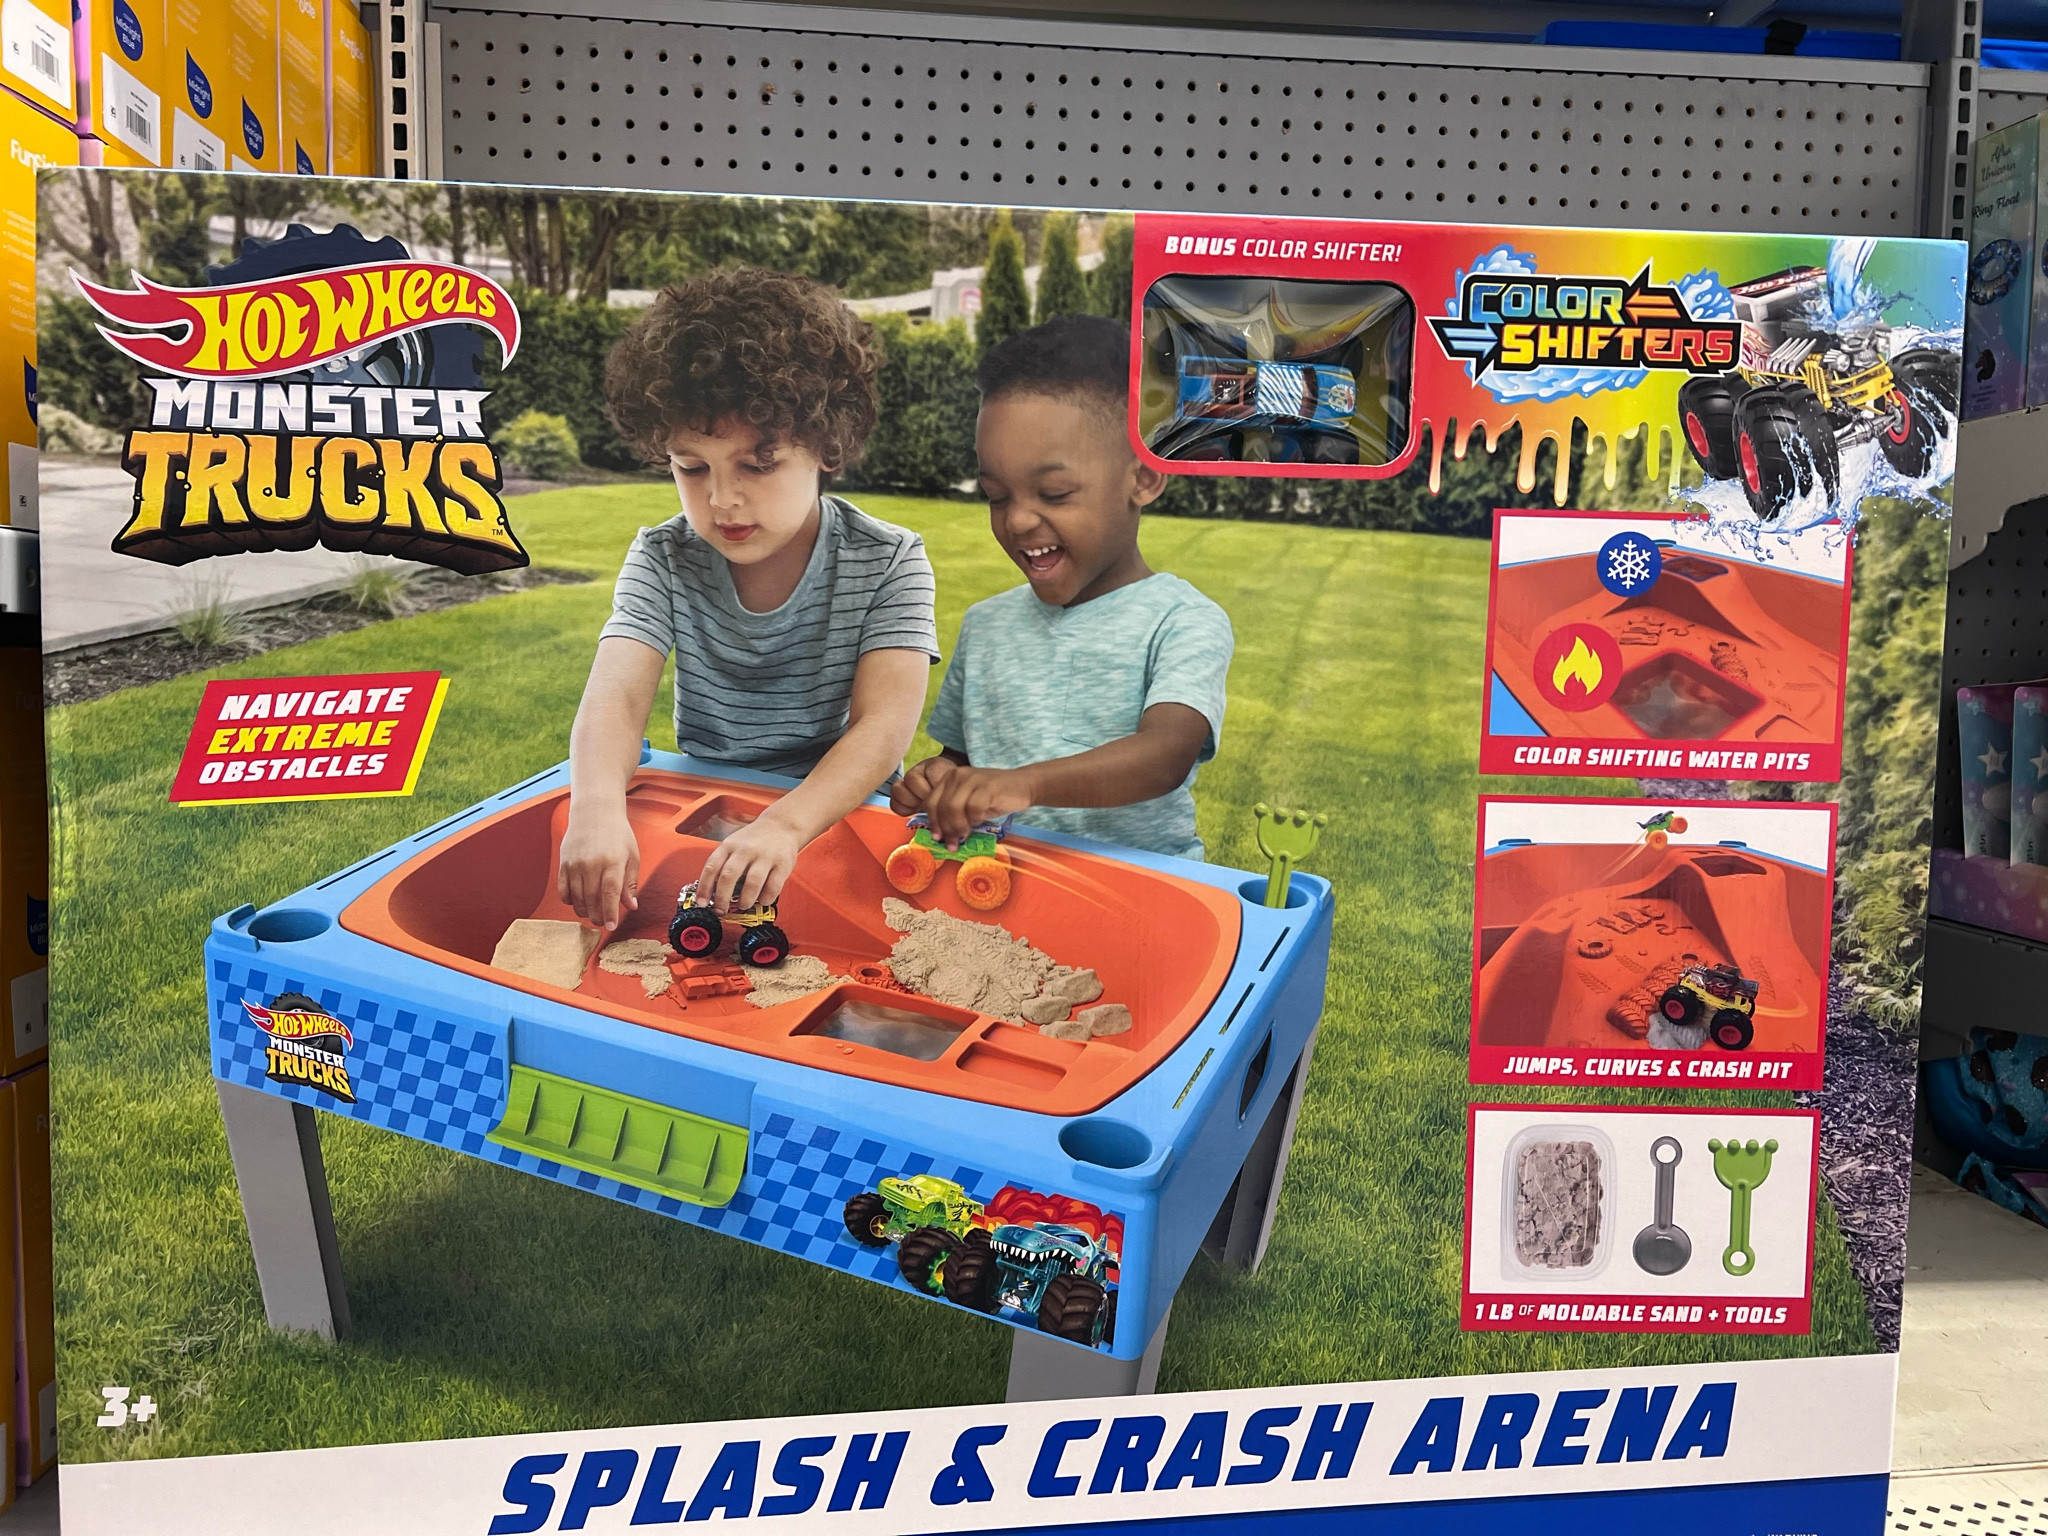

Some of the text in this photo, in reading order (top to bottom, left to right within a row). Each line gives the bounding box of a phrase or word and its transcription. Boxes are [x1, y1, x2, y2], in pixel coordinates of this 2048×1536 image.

[1973, 192, 2020, 218] Ring Float
[1165, 236, 1402, 262] BONUS COLOR SHIFTER!
[1469, 282, 1626, 325] COLOR
[1501, 323, 1733, 367] SHIFTERS
[144, 378, 494, 438] MONSTER
[119, 431, 521, 555] TRUCKS
[218, 687, 413, 721] NAVIGATE
[206, 719, 399, 755] EXTREME
[198, 753, 388, 784] OBSTACLES
[1514, 746, 1810, 771] COLOR SHIFTING WATER PITS
[268, 1035, 346, 1068] MONSTER
[1503, 1056, 1793, 1080] JUMPS, CURVES & CRASH PIT
[266, 1048, 356, 1102] TRUCKS
[1475, 1304, 1484, 1320] 1
[1489, 1304, 1514, 1321] LB
[1518, 1304, 1534, 1316] OF
[1537, 1304, 1646, 1322] MOLDABLE
[1649, 1305, 1703, 1323] SAND
[1725, 1306, 1788, 1324] TOOLS
[97, 1386, 158, 1427] 3+
[487, 1381, 1738, 1536] SPLASH & CRASH ARENA
